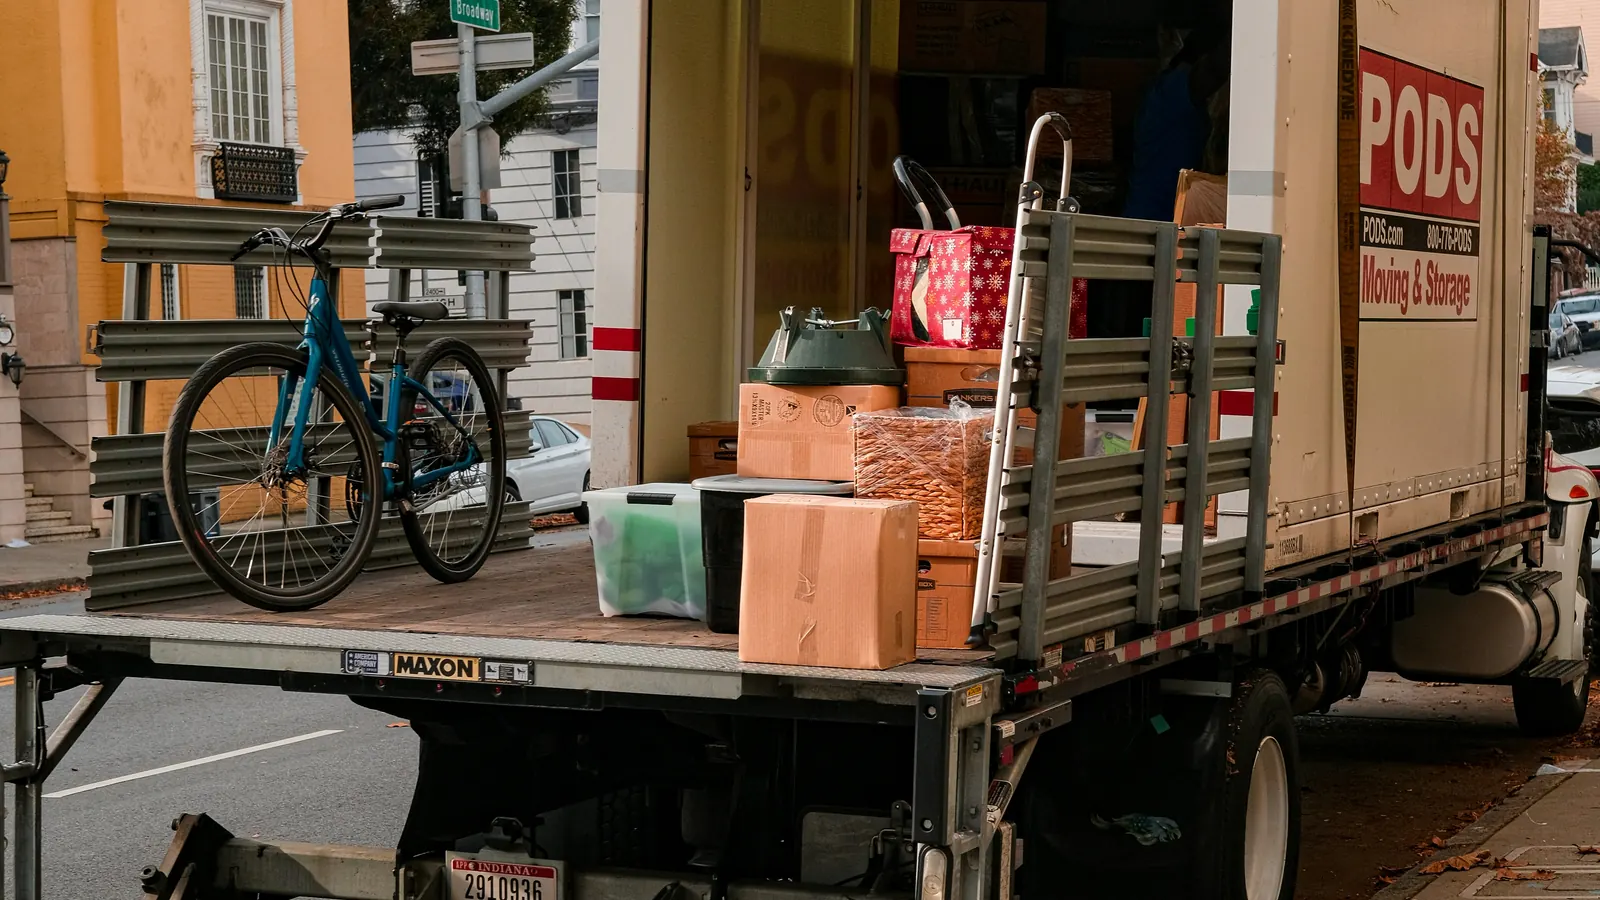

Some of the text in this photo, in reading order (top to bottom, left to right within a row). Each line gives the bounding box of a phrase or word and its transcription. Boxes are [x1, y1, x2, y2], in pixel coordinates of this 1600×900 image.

[457, 0, 494, 26] Broadway
[1341, 24, 1355, 120] KINEDYNE
[1360, 71, 1479, 204] PODS
[1363, 216, 1403, 245] PODS.com
[1427, 224, 1472, 252] 800-776-PODS
[1362, 255, 1470, 315] Moving & Storage
[397, 656, 473, 678] MAXON
[478, 862, 531, 875] INDIANA
[465, 874, 541, 900] 2910936
